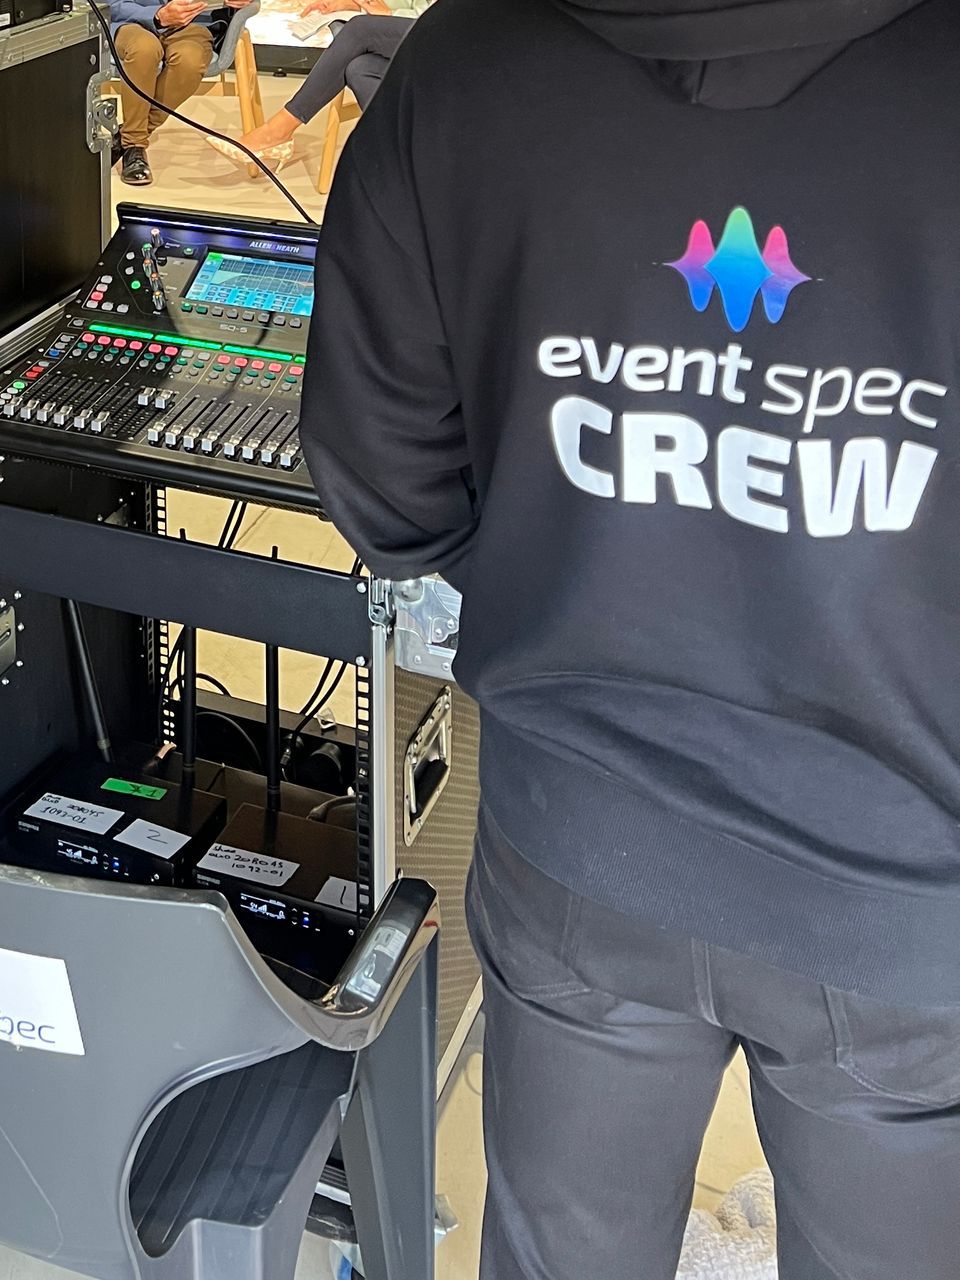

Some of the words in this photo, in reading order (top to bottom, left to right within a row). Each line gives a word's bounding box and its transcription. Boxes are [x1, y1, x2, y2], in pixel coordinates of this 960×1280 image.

[538, 335, 753, 404] event
[760, 363, 948, 434] spec
[551, 394, 938, 538] CREW
[146, 828, 169, 845] 2
